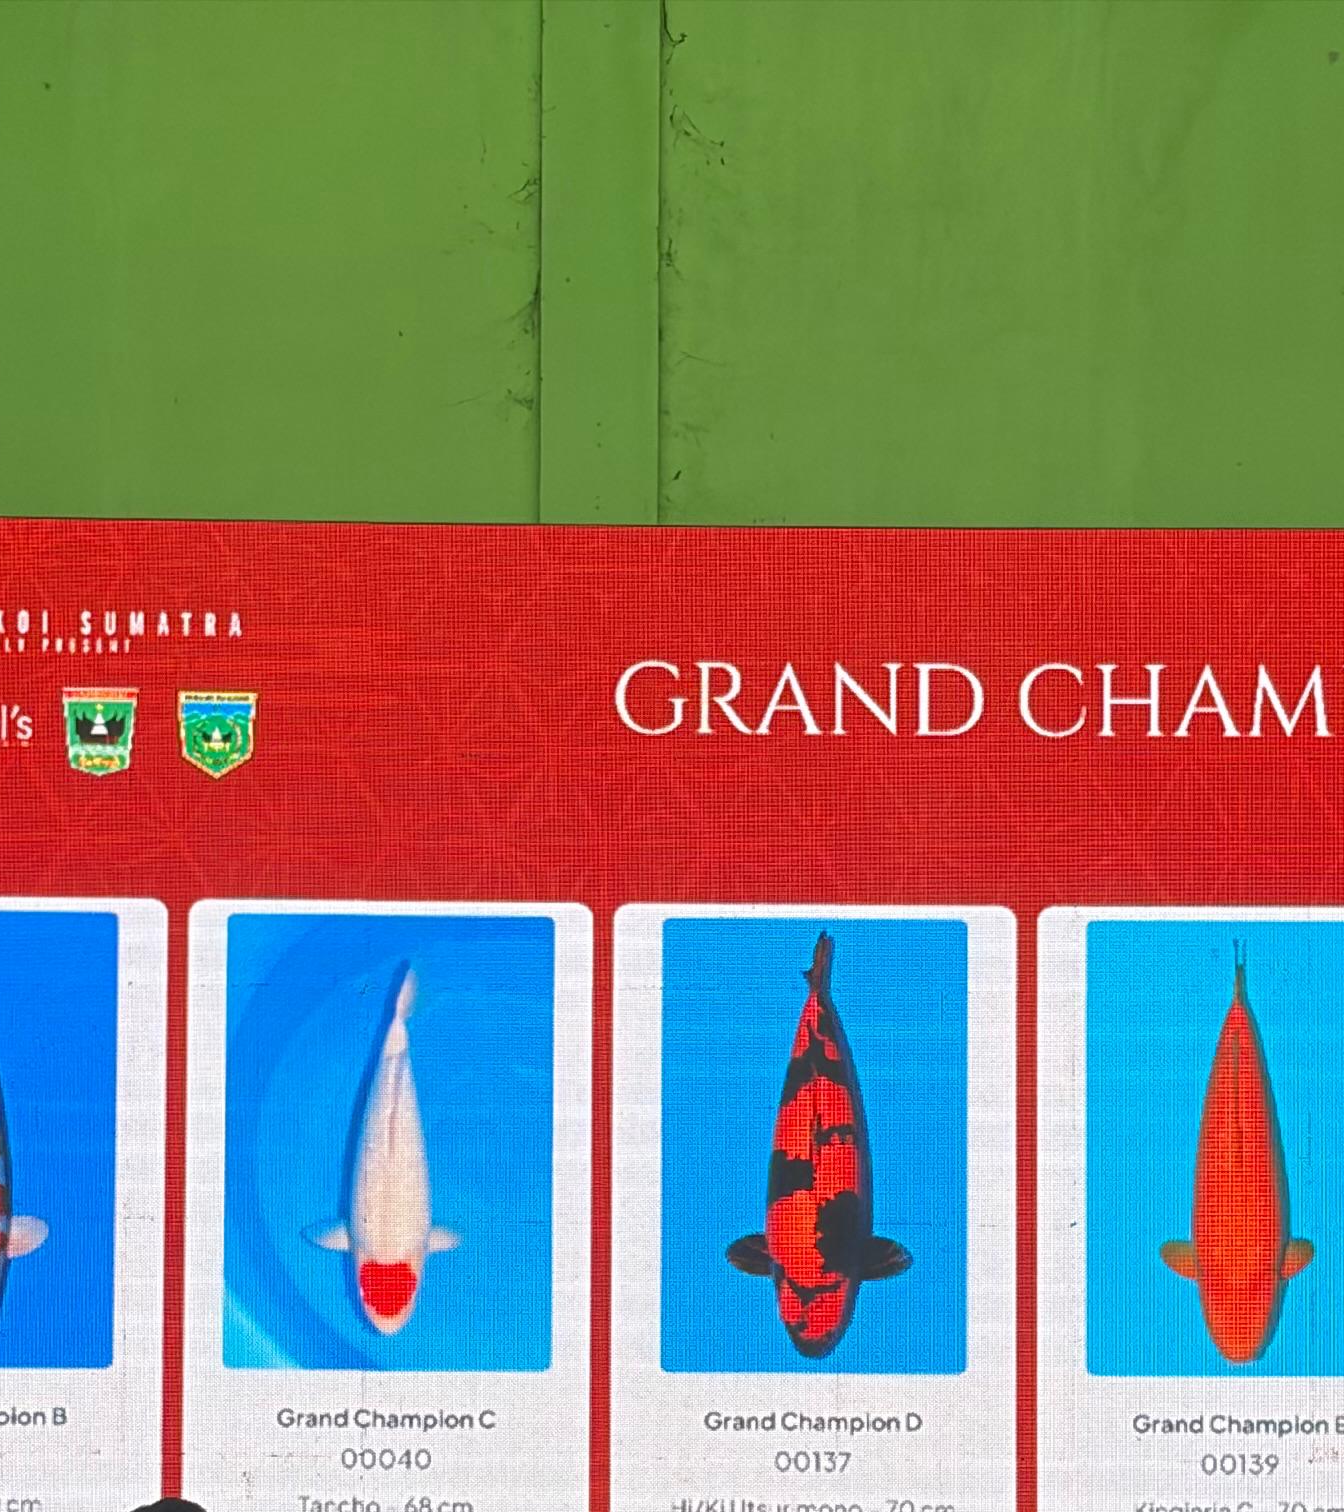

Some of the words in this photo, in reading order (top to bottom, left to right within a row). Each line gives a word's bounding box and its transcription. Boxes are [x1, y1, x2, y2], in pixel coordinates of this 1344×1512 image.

[80, 610, 242, 637] SUMATRA
[614, 659, 985, 737] GRAND
[53, 1408, 67, 1425] B
[277, 1408, 348, 1428] Grand
[355, 1409, 473, 1432] Champion
[479, 1410, 496, 1429] C
[704, 1411, 776, 1432] Grand
[781, 1412, 900, 1435] Champion
[906, 1413, 922, 1432] D
[1133, 1414, 1203, 1434] Grand
[1210, 1415, 1329, 1437] Champion
[341, 1449, 432, 1470] 00040
[775, 1451, 851, 1472] 00137
[1201, 1454, 1279, 1475] 00139
[7, 1499, 41, 1512] cm
